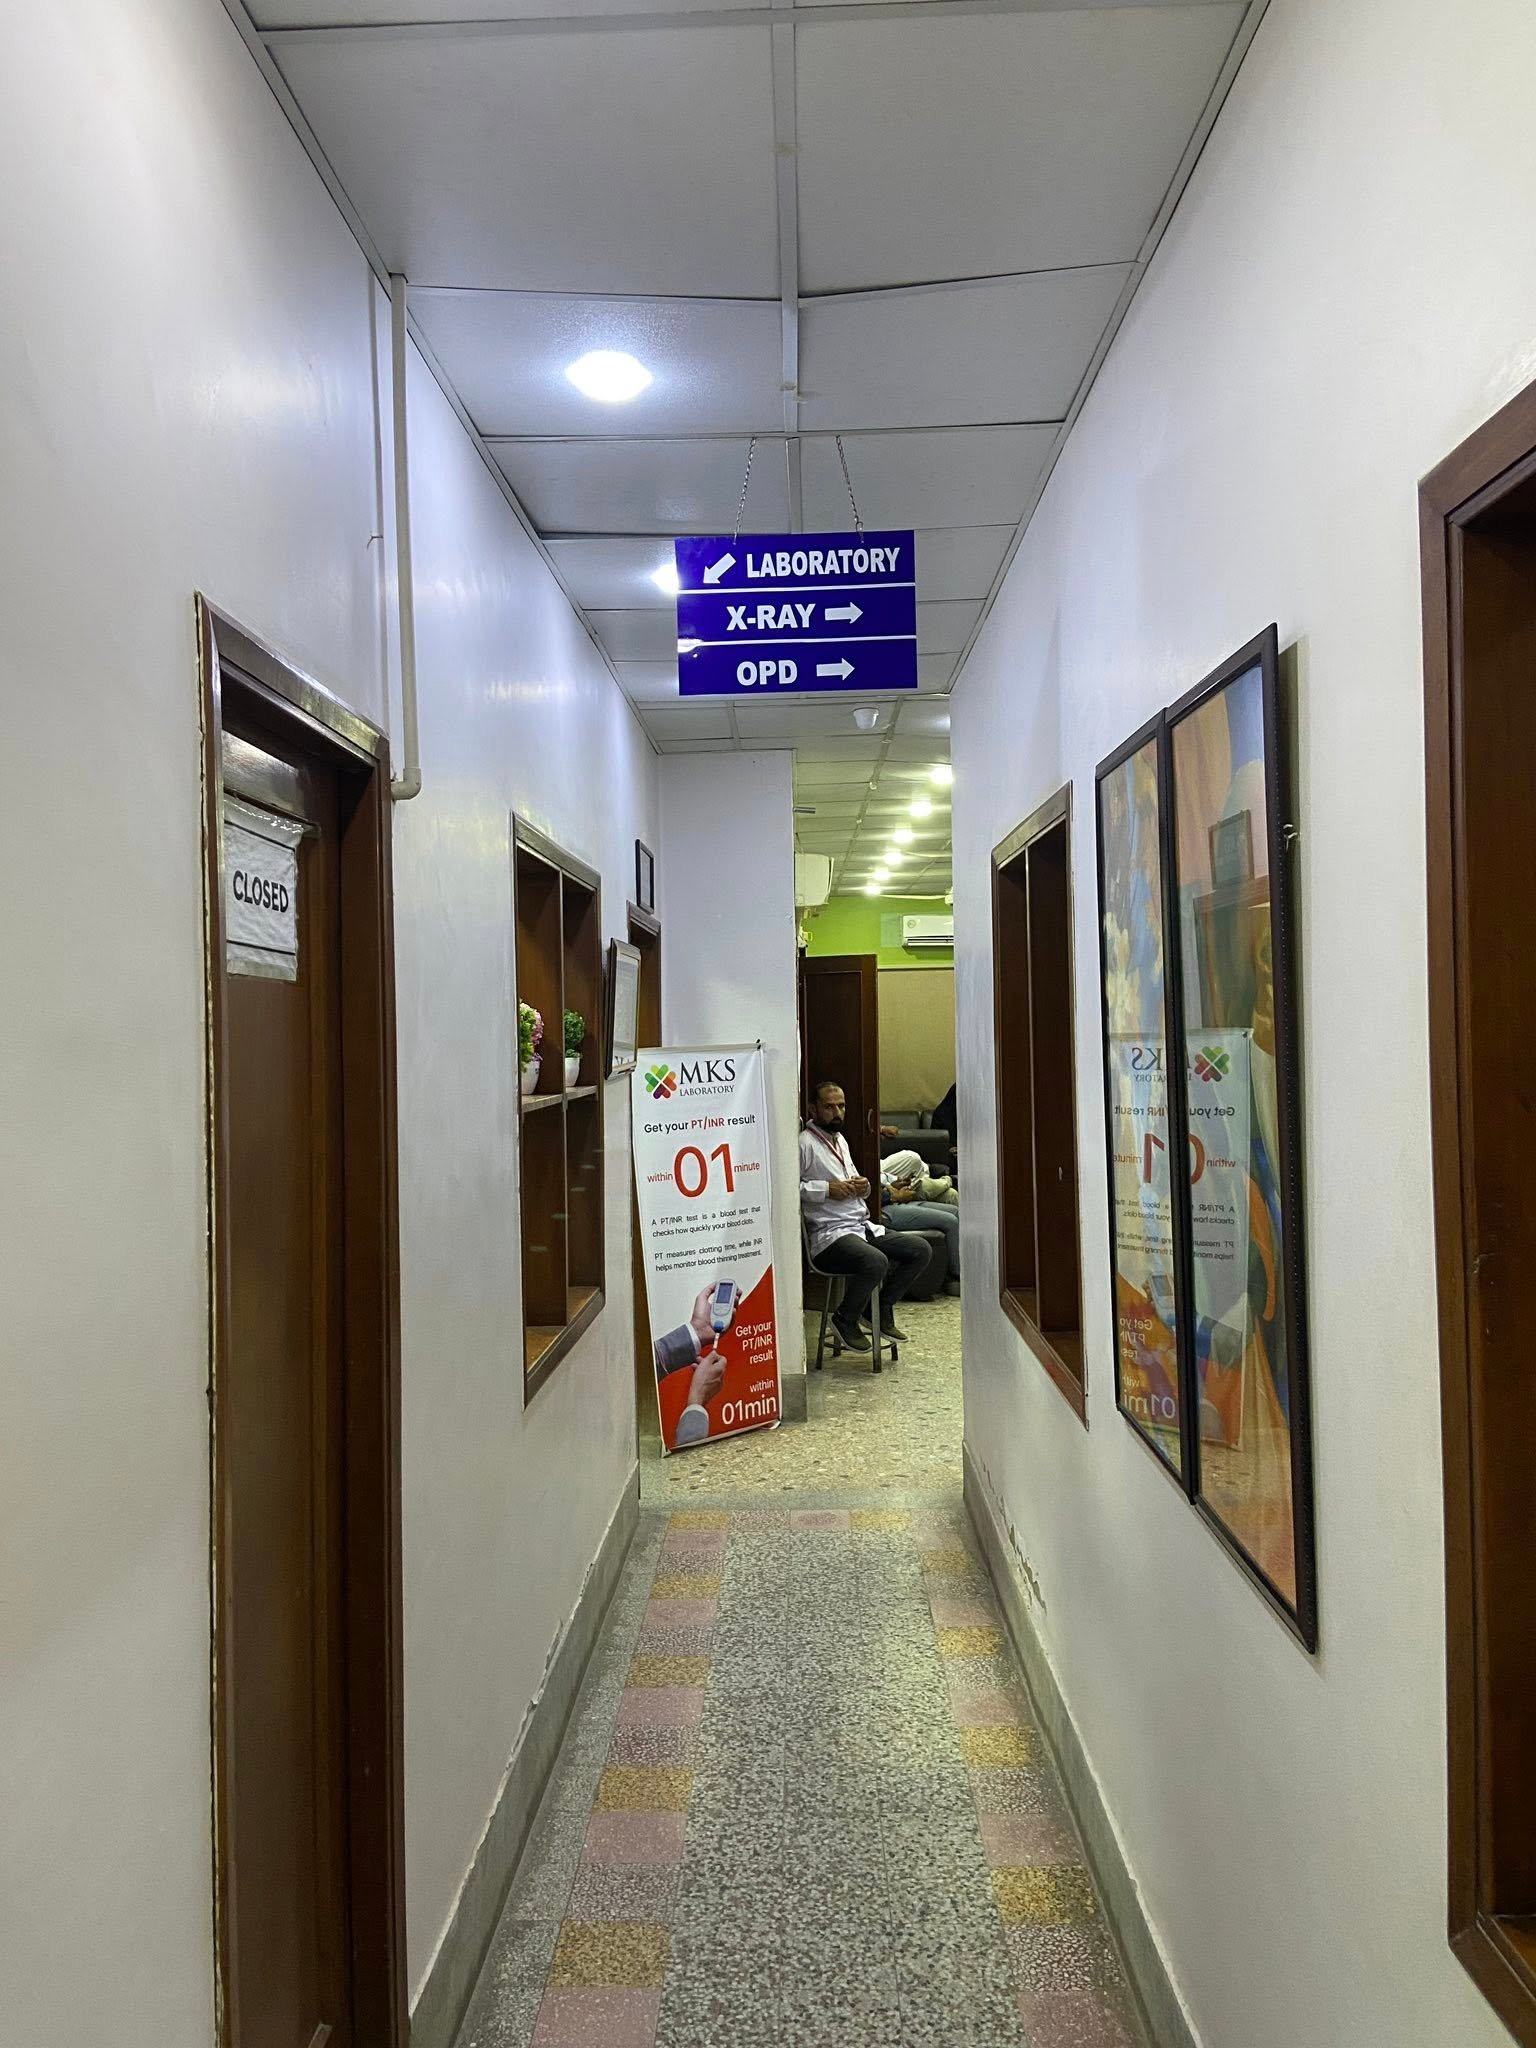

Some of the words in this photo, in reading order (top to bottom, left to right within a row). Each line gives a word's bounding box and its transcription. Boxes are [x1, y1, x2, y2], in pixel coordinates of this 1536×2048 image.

[746, 547, 900, 578] LABORATORY
[726, 603, 816, 631] X-RAY
[736, 659, 798, 686] OPD
[233, 870, 289, 913] CLOSED
[680, 1058, 736, 1085] MKS
[680, 1085, 735, 1097] LABORATORY
[644, 1123, 663, 1133] Get
[665, 1121, 689, 1134] your
[691, 1116, 725, 1130] PT/INR
[727, 1114, 756, 1126] result
[647, 1170, 673, 1183] within
[673, 1143, 735, 1198] 01
[734, 1161, 760, 1173] minute
[660, 1215, 683, 1226] PT/INR
[686, 1214, 698, 1222] test
[720, 1209, 736, 1218] blood
[751, 1205, 761, 1213] that
[652, 1228, 675, 1238] checks
[675, 1227, 689, 1235] how
[689, 1223, 711, 1233] quickly
[711, 1222, 726, 1231] your
[726, 1220, 741, 1228] blood
[654, 1252, 663, 1260] PT
[666, 1248, 696, 1259] measures
[699, 1245, 723, 1255] clotting
[753, 1237, 763, 1246] INR
[655, 1263, 673, 1272] helps
[673, 1261, 697, 1269] monitor
[697, 1257, 716, 1266] blood
[716, 1254, 738, 1263] thinning
[735, 1325, 752, 1337] Get
[752, 1320, 772, 1335] your
[742, 1333, 773, 1351] PT/INR
[749, 1349, 774, 1364] result
[750, 1378, 774, 1393] within
[721, 1394, 777, 1425] 01min
